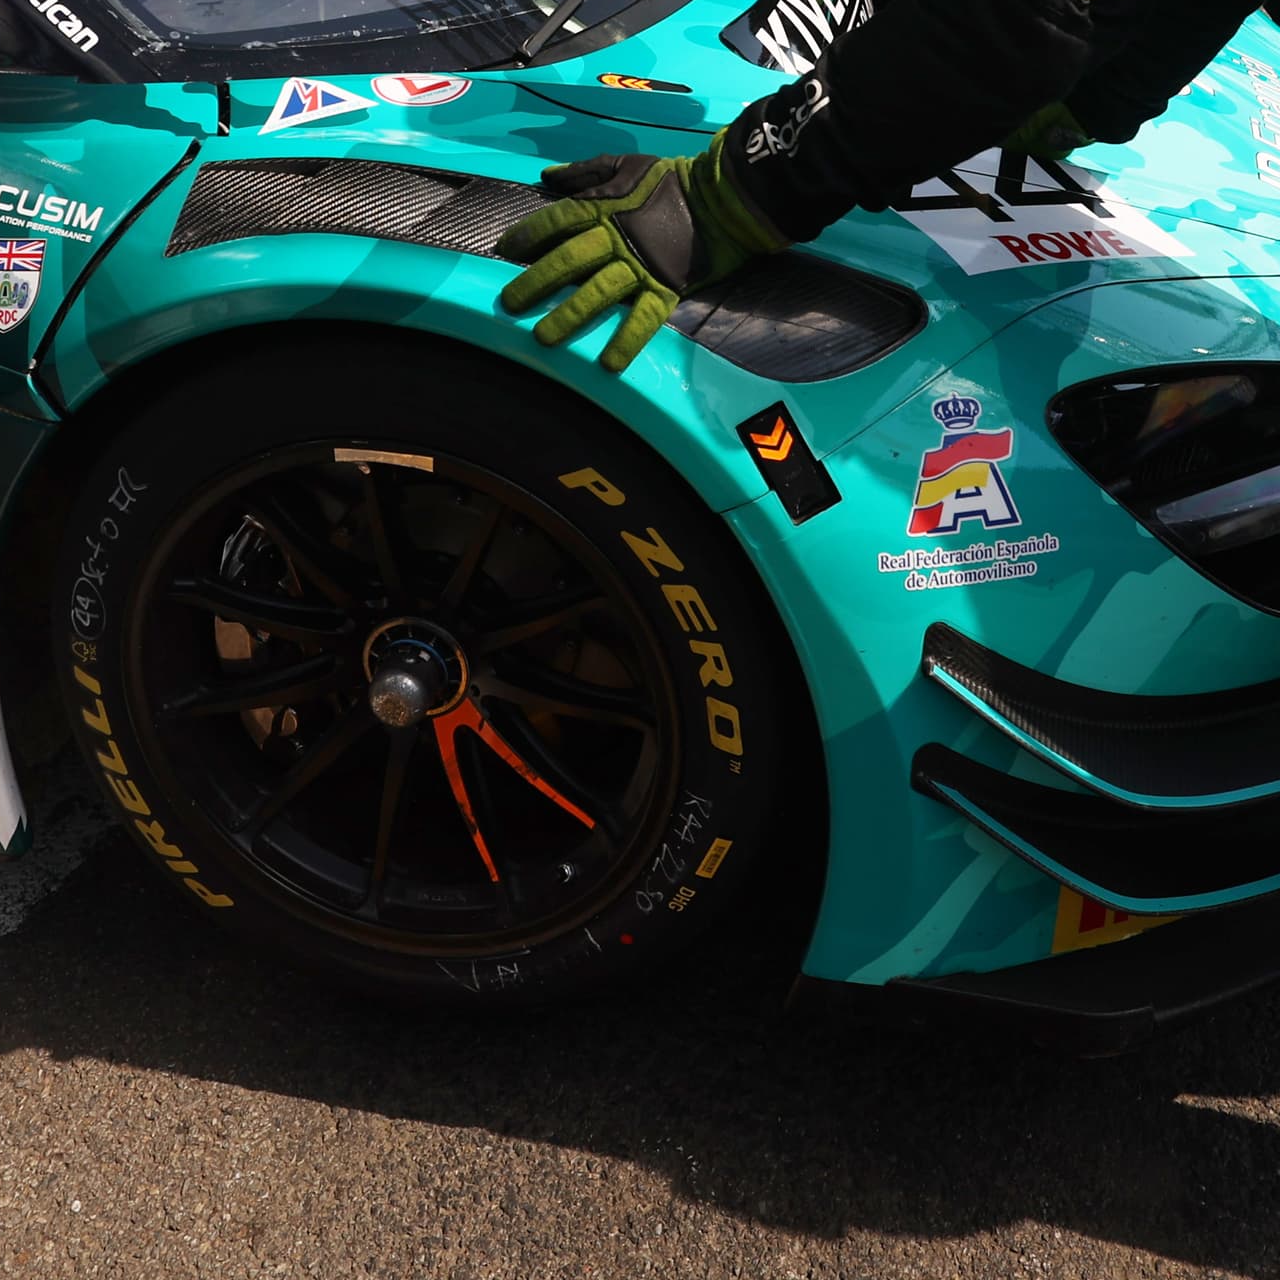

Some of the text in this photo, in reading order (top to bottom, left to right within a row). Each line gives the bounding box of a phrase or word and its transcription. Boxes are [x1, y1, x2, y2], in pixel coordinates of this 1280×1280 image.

[26, 221, 94, 243] PERFORMANCE
[989, 229, 1138, 264] ROWE
[879, 534, 1057, 571] Real Federación Española
[906, 562, 1036, 589] de Automovilismo
[557, 465, 745, 757] P ZERO
[72, 666, 235, 910] PIRELLI
